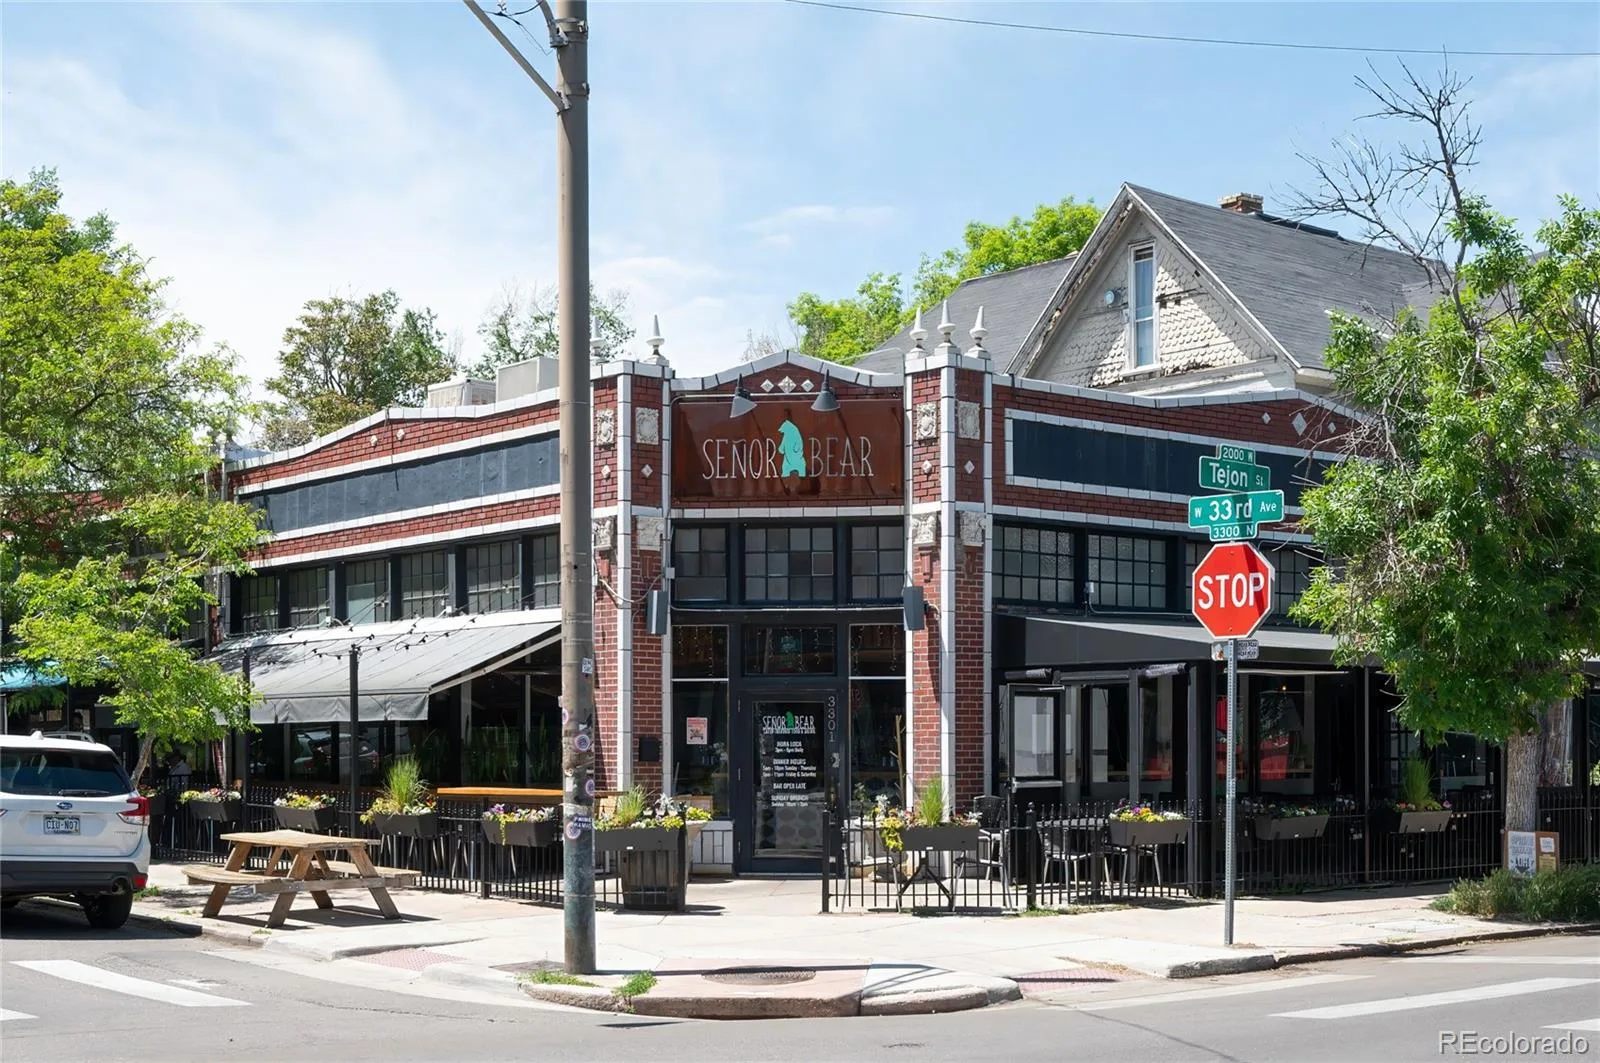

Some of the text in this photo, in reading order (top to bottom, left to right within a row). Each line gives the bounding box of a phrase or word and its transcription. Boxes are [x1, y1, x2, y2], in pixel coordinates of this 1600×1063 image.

[702, 436, 874, 480] SEÑOR BEAR
[1222, 447, 1244, 461] 2000
[1209, 462, 1264, 488] Tejon St
[1194, 498, 1277, 521] W 33rd Ave
[1213, 524, 1254, 538] 3300 N
[1198, 572, 1265, 610] STOP
[794, 715, 815, 729] BEAR
[827, 695, 836, 742] 3301
